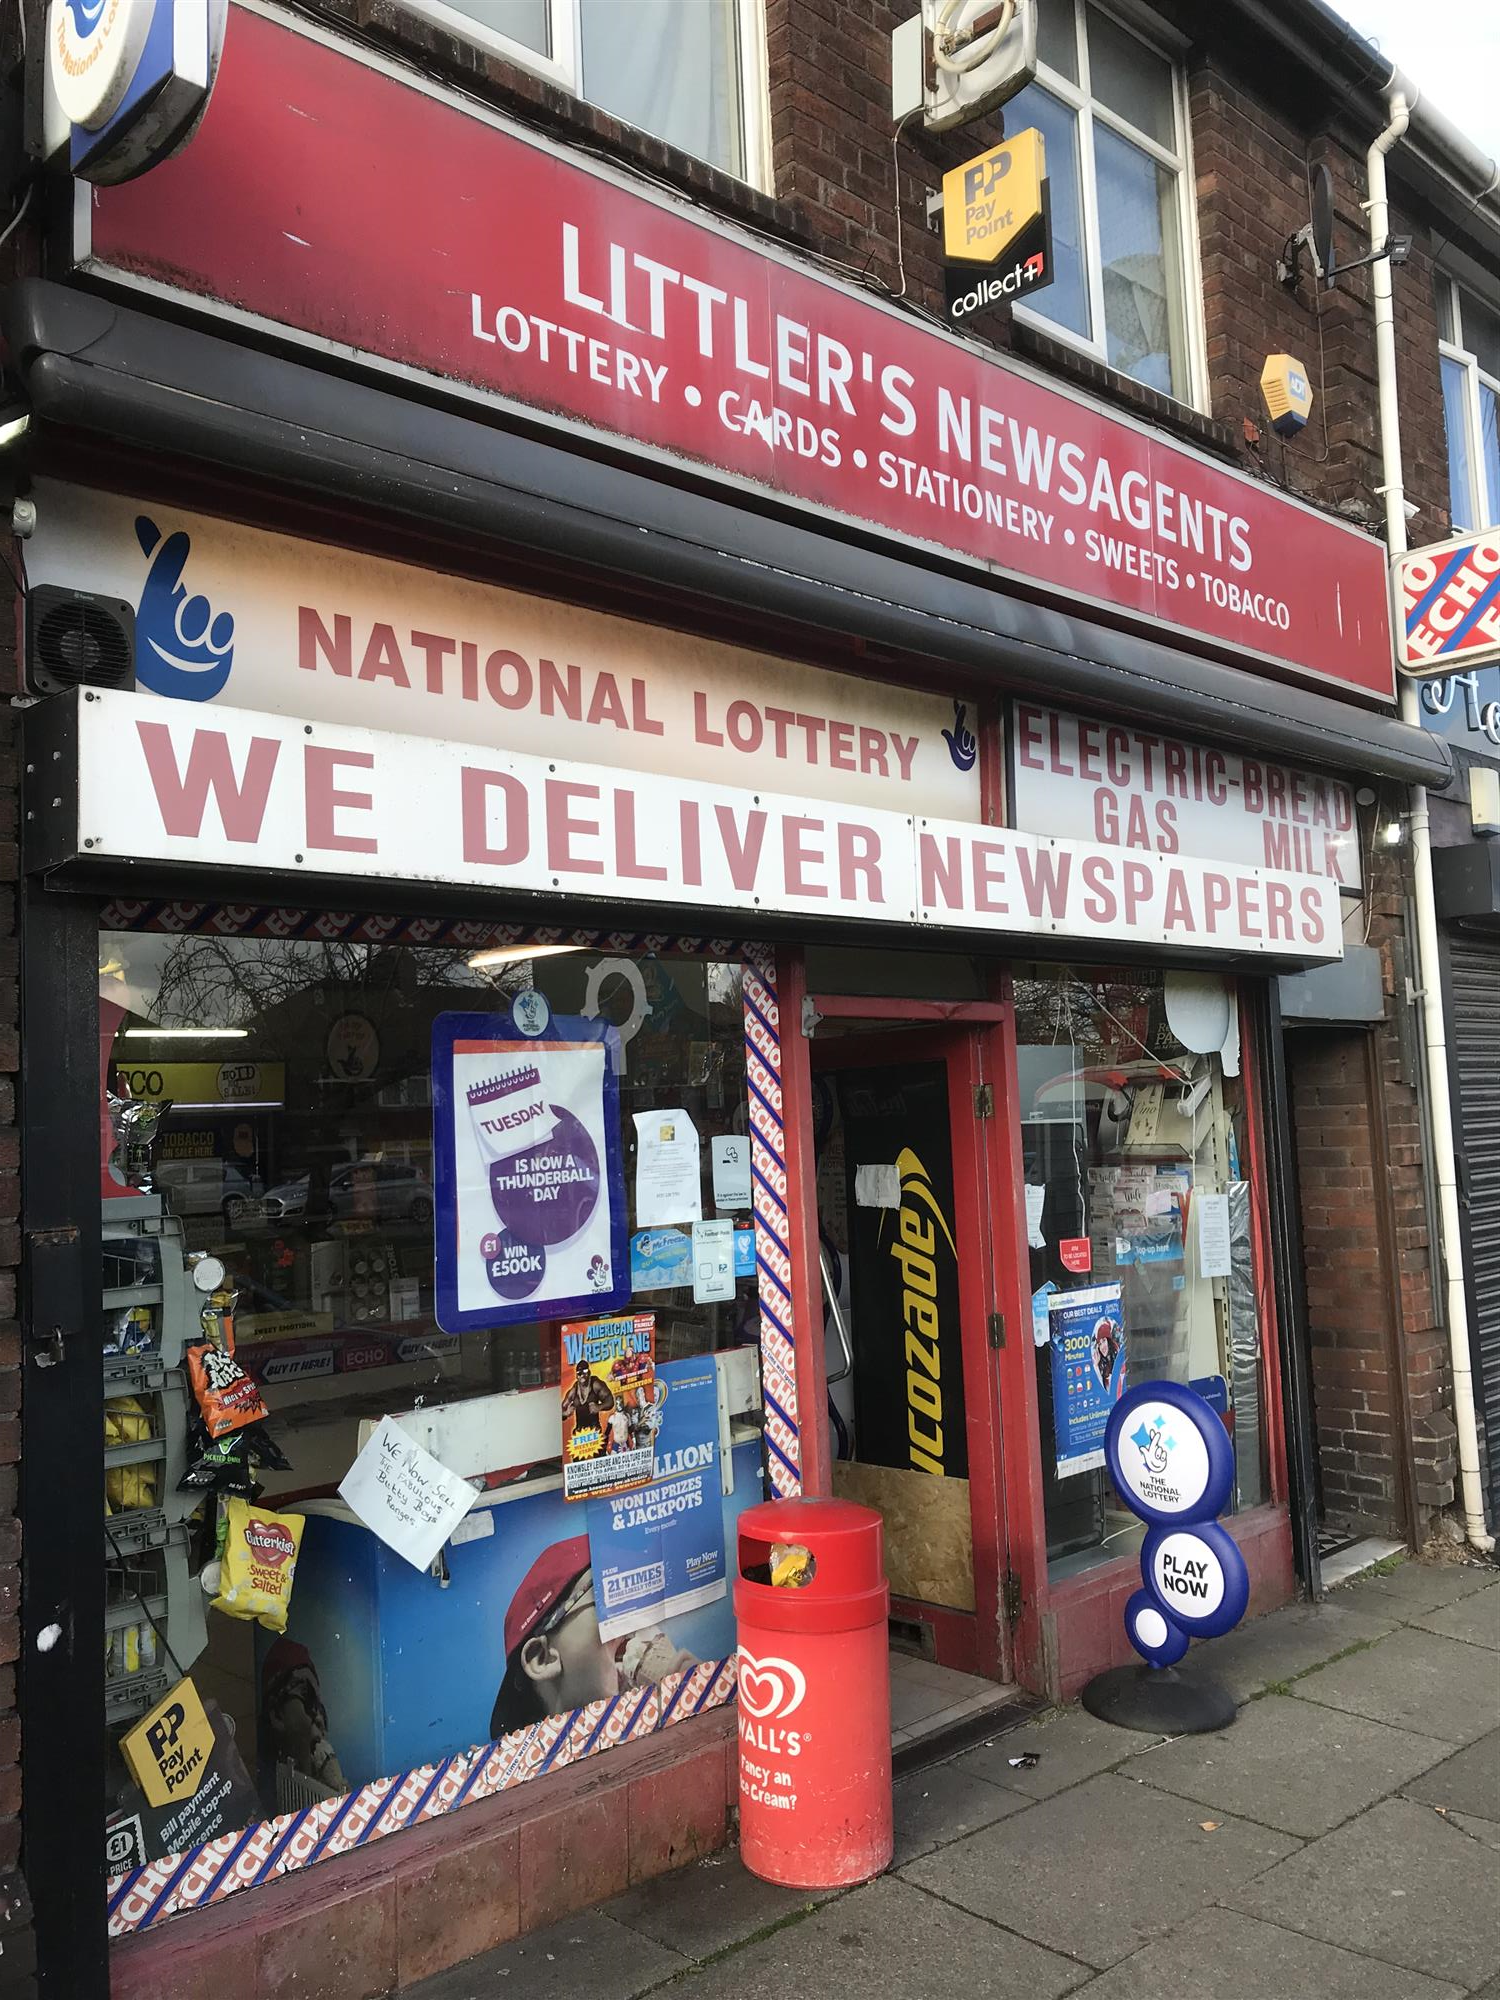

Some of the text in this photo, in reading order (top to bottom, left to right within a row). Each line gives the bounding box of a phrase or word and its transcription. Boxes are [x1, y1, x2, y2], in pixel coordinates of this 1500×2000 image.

[63, 38, 104, 78] National
[965, 199, 996, 226] Pay
[966, 208, 1014, 245] Point
[562, 222, 1253, 573] LITTLER'S NEWSAGENTS
[471, 293, 1291, 631] LOTTERY CARDS STATIONERY SWEETS TOBACCO
[298, 604, 920, 781] NATIONAL LOTTERY
[1018, 704, 1353, 833] ELECTRIC-BREAD
[135, 719, 1324, 944] WE DELIVER NEWSPAPERS
[1093, 786, 1179, 855] GAS
[1261, 819, 1344, 883] MILK
[480, 1101, 545, 1135] TUESDAY
[163, 1131, 214, 1148] TOBACCO
[515, 1154, 576, 1173] IS NOW A
[496, 1168, 595, 1191] THUNDERBALL
[533, 1186, 560, 1202] DAY
[484, 1240, 497, 1252] £1
[504, 1245, 528, 1259] WIN
[491, 1256, 542, 1277] £500K
[1063, 1310, 1074, 1319] OUR
[1074, 1308, 1086, 1317] BEST
[1087, 1305, 1103, 1315] DEALS
[587, 1320, 634, 1340] AMERICAN
[1064, 1335, 1091, 1352] 3000
[267, 1357, 331, 1376] BUY IT HERE!
[347, 1348, 384, 1366] ECHO
[379, 1453, 393, 1474] THE
[567, 1449, 652, 1474] KNOWSLEY LEISURE AND CULTURE PARK
[1139, 1480, 1181, 1497] NATIONAL
[1149, 1475, 1167, 1486] THE
[610, 1492, 645, 1513] WON
[646, 1487, 662, 1505] IN
[661, 1476, 703, 1500] PRIZES
[1142, 1489, 1180, 1503] LOTTERY
[613, 1490, 703, 1532] & JACKPOTS
[245, 1530, 295, 1556] Butterkist
[685, 1550, 718, 1569] Play Now
[1163, 1553, 1209, 1580] PLAY
[249, 1564, 280, 1583] Sweet
[607, 1565, 662, 1593] 21 TIMES
[1163, 1573, 1209, 1599] NOW
[158, 1744, 184, 1777] Pay
[165, 1746, 204, 1795] Point
[773, 1771, 792, 1787] an
[159, 1771, 221, 1843] Bill payment
[750, 1783, 798, 1811] Cream?
[166, 1779, 233, 1855] Mobile top-up
[109, 1859, 134, 1876] PRICE
